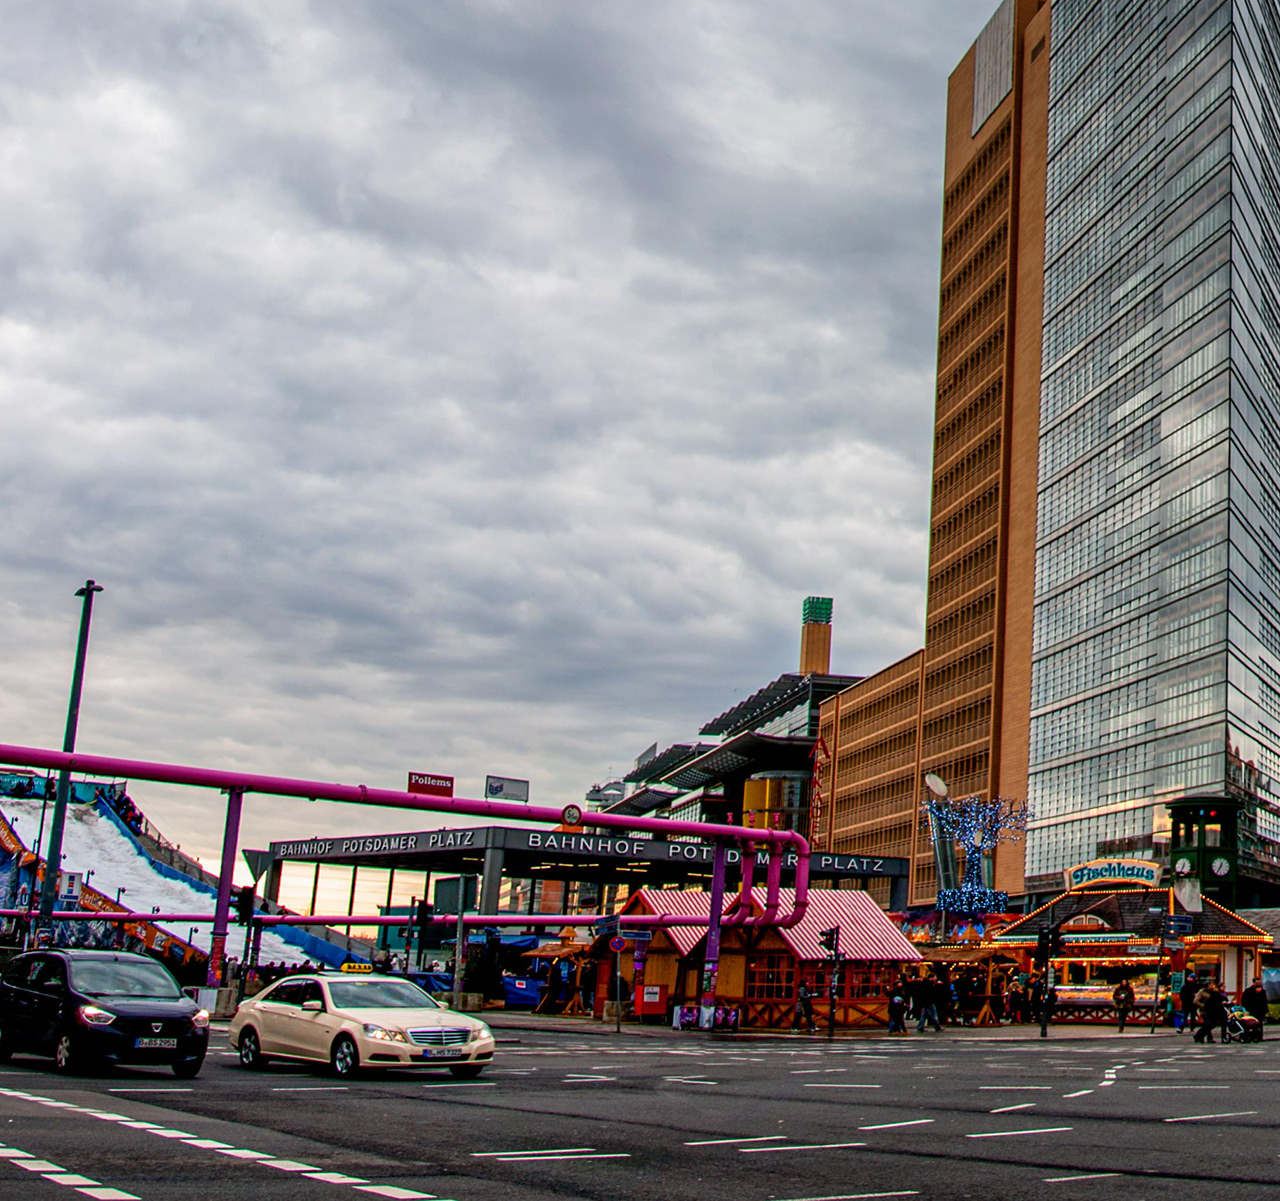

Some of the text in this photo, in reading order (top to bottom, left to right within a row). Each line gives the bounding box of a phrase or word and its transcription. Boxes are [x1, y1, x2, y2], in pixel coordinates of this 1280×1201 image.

[411, 774, 452, 788] Pollems
[279, 831, 474, 856] BAHNHOF POTSDAMER PLATZ
[528, 833, 884, 872] BAHNHOF POTDMR PLATZ
[1072, 862, 1155, 886] Fischhaus
